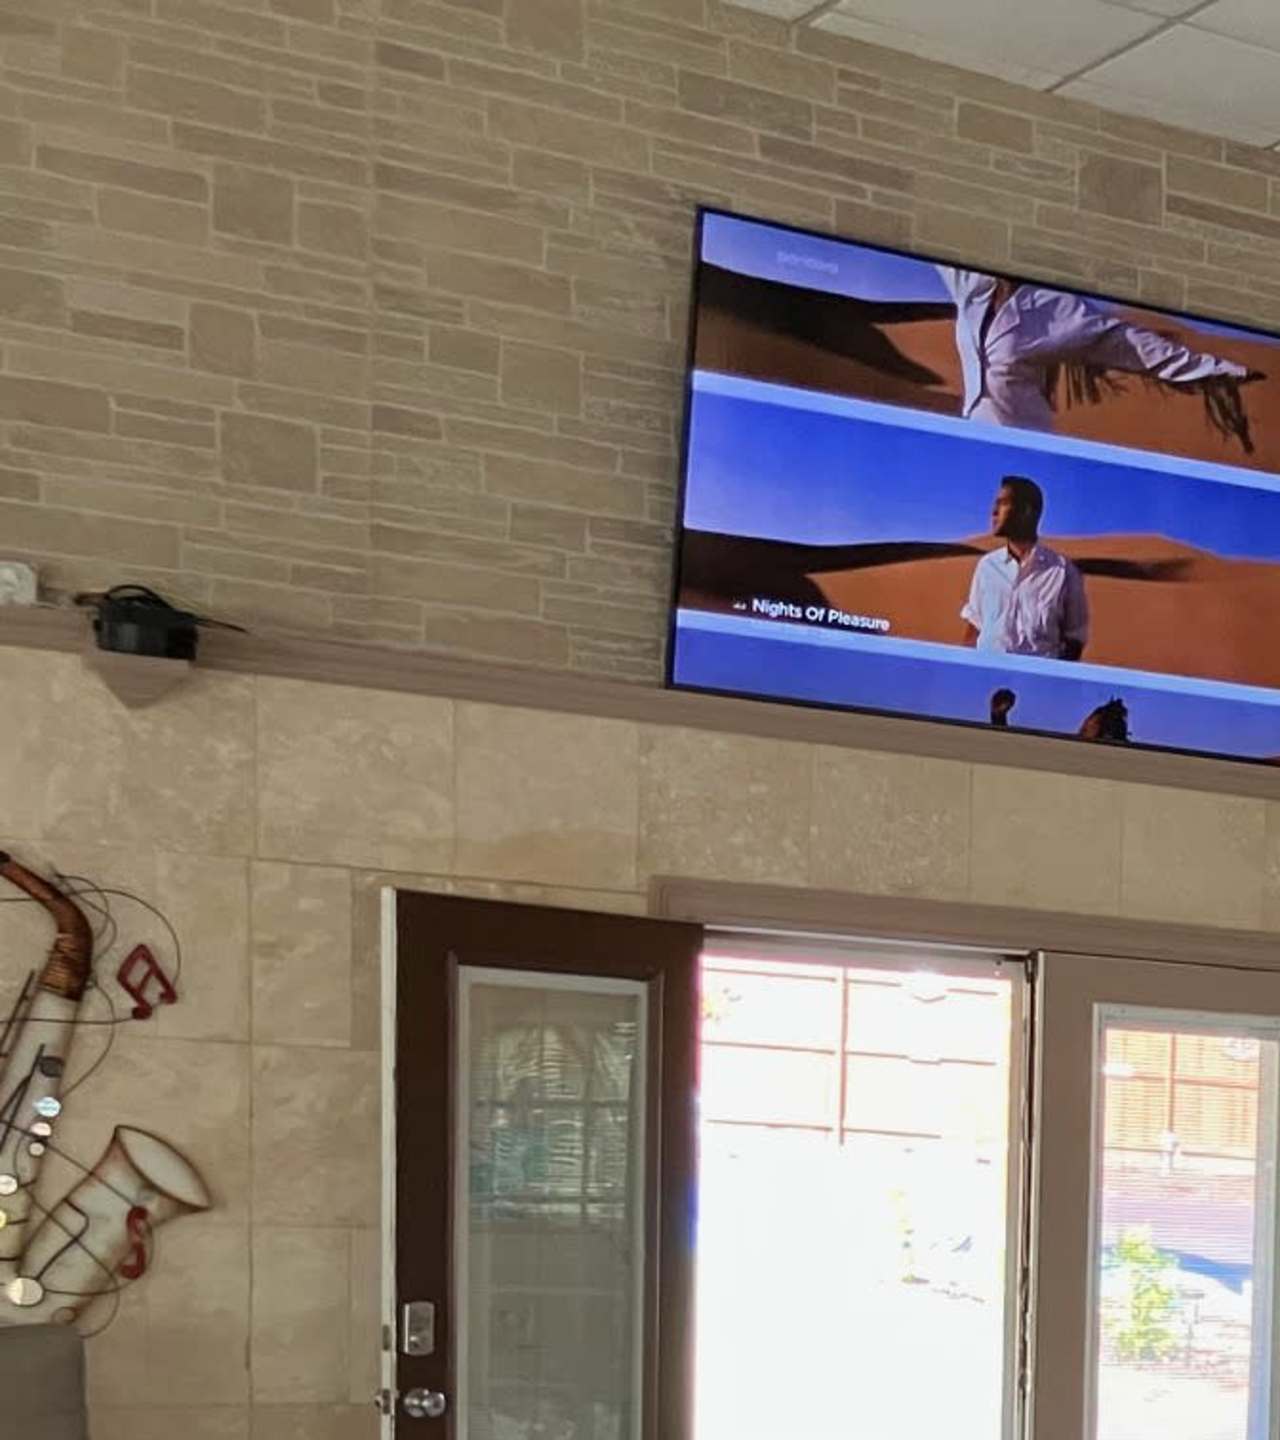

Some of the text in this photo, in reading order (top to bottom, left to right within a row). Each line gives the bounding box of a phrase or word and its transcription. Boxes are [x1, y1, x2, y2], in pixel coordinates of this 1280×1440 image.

[752, 597, 891, 632] Nights Of Pleasure
